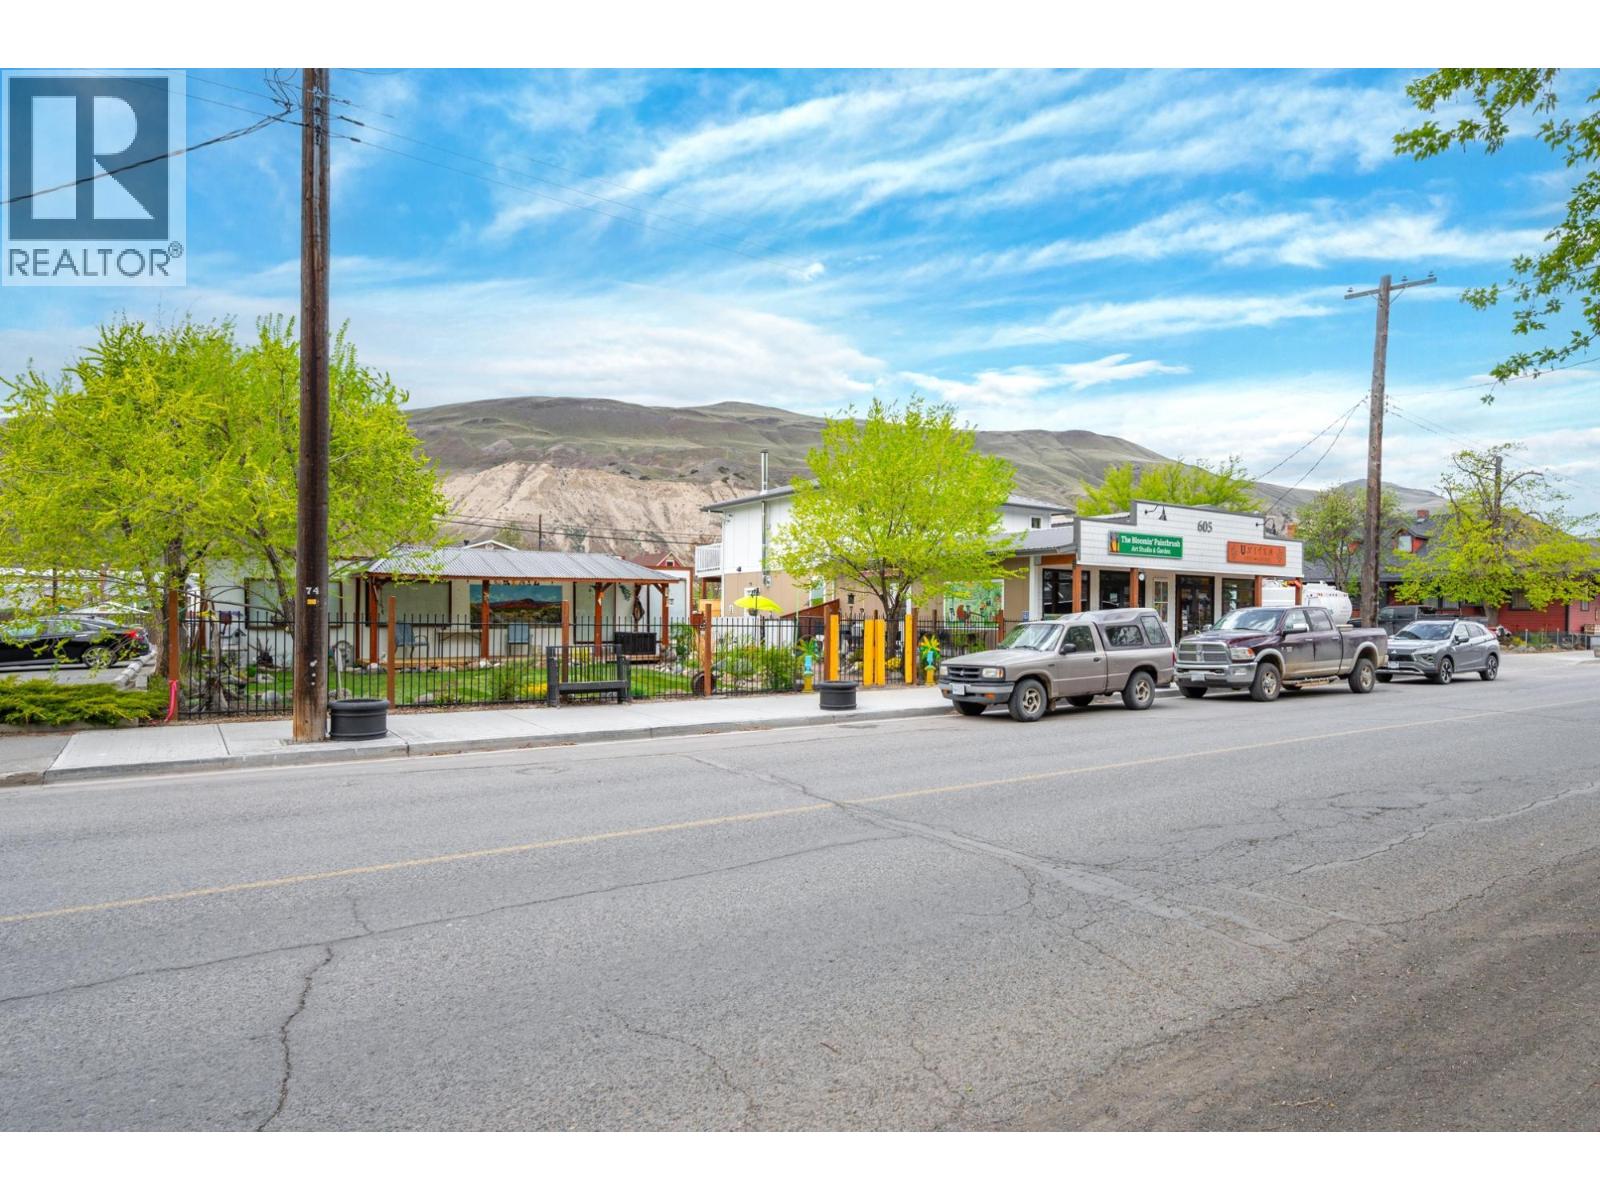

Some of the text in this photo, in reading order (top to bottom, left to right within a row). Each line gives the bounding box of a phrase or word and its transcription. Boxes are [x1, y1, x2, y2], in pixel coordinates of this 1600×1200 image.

[1197, 520, 1213, 533] 605
[1121, 535, 1131, 543] The
[1154, 538, 1181, 547] Paintbrush
[1131, 545, 1139, 553] Art
[1139, 545, 1153, 553] Studio
[1156, 547, 1171, 555] Garden
[305, 586, 320, 595] 74
